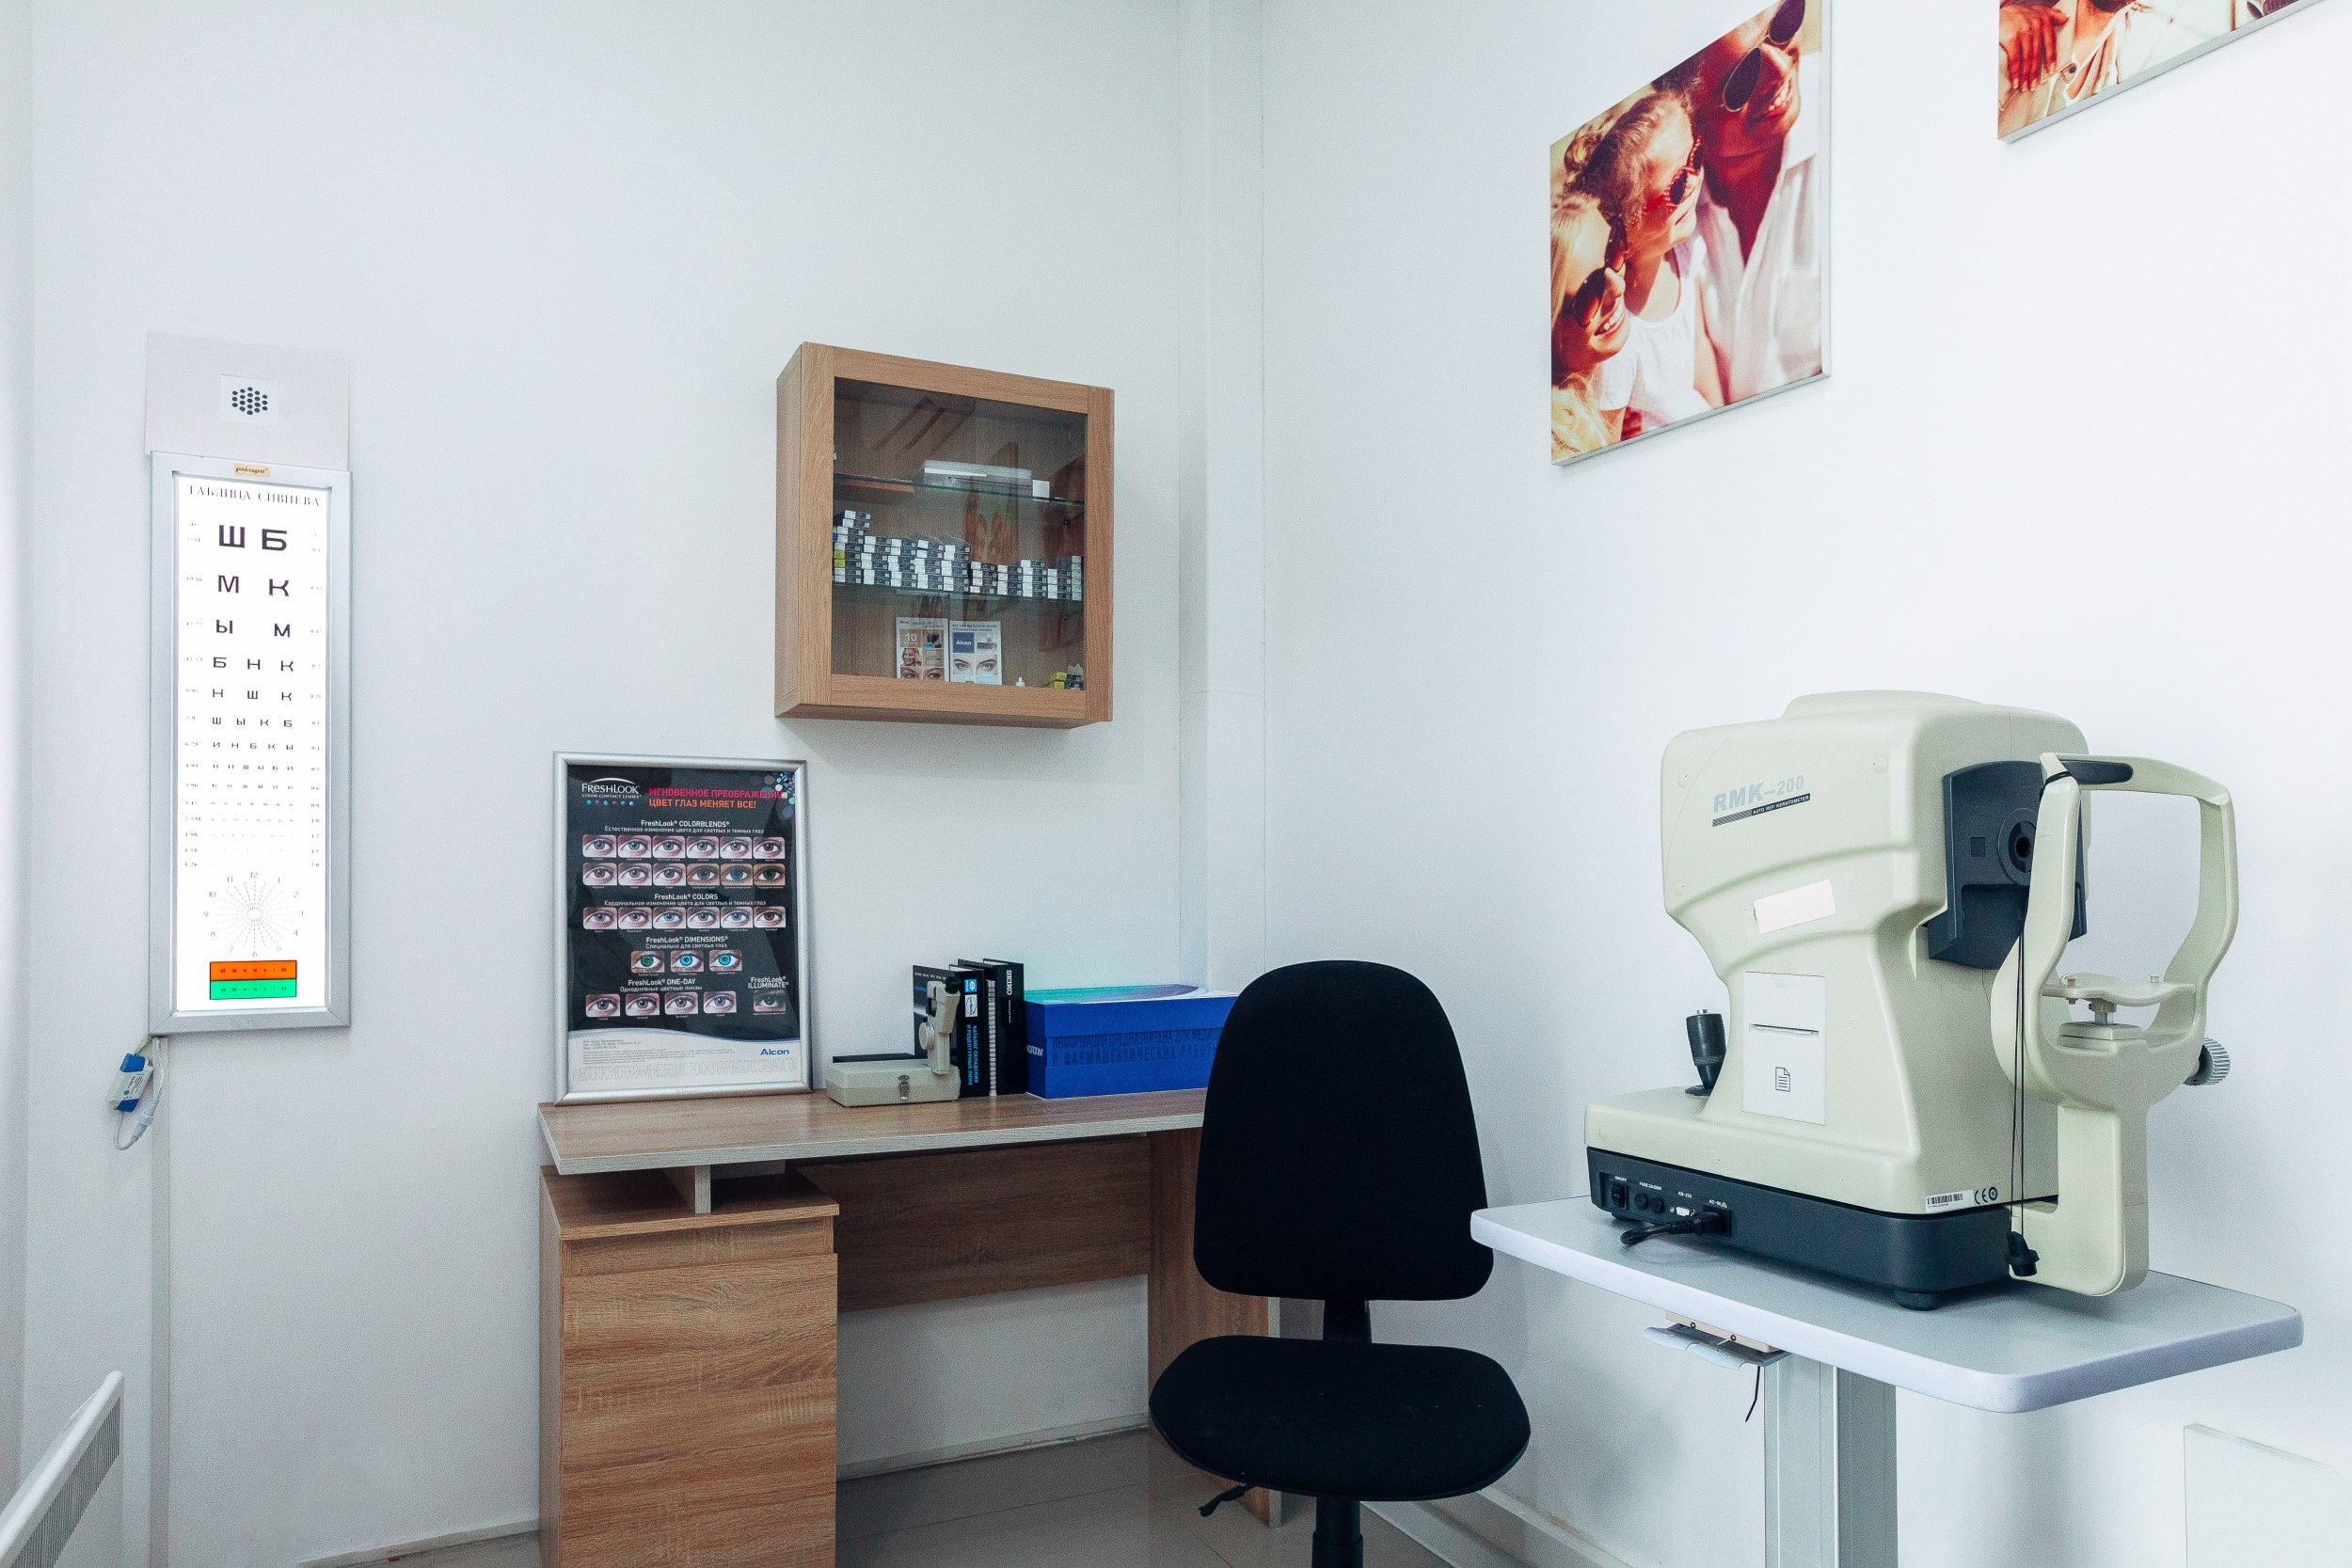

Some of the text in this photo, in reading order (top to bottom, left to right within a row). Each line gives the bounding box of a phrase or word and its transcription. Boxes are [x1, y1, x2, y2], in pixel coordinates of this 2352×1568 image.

[219, 525, 245, 548] Ш
[262, 529, 287, 551] Б
[218, 575, 289, 596] М К
[216, 620, 290, 638] Ы М
[214, 657, 227, 668] Б
[247, 658, 261, 670] Н
[281, 660, 294, 672] К
[213, 689, 293, 701] Н Ш К
[648, 787, 709, 798] МГНОВЕННОЕ
[1714, 775, 1804, 813] RMK-200
[649, 799, 673, 807] ЦВЕТ
[700, 800, 735, 808] МЕНЯЕТ
[738, 800, 756, 809] ВСЕ!
